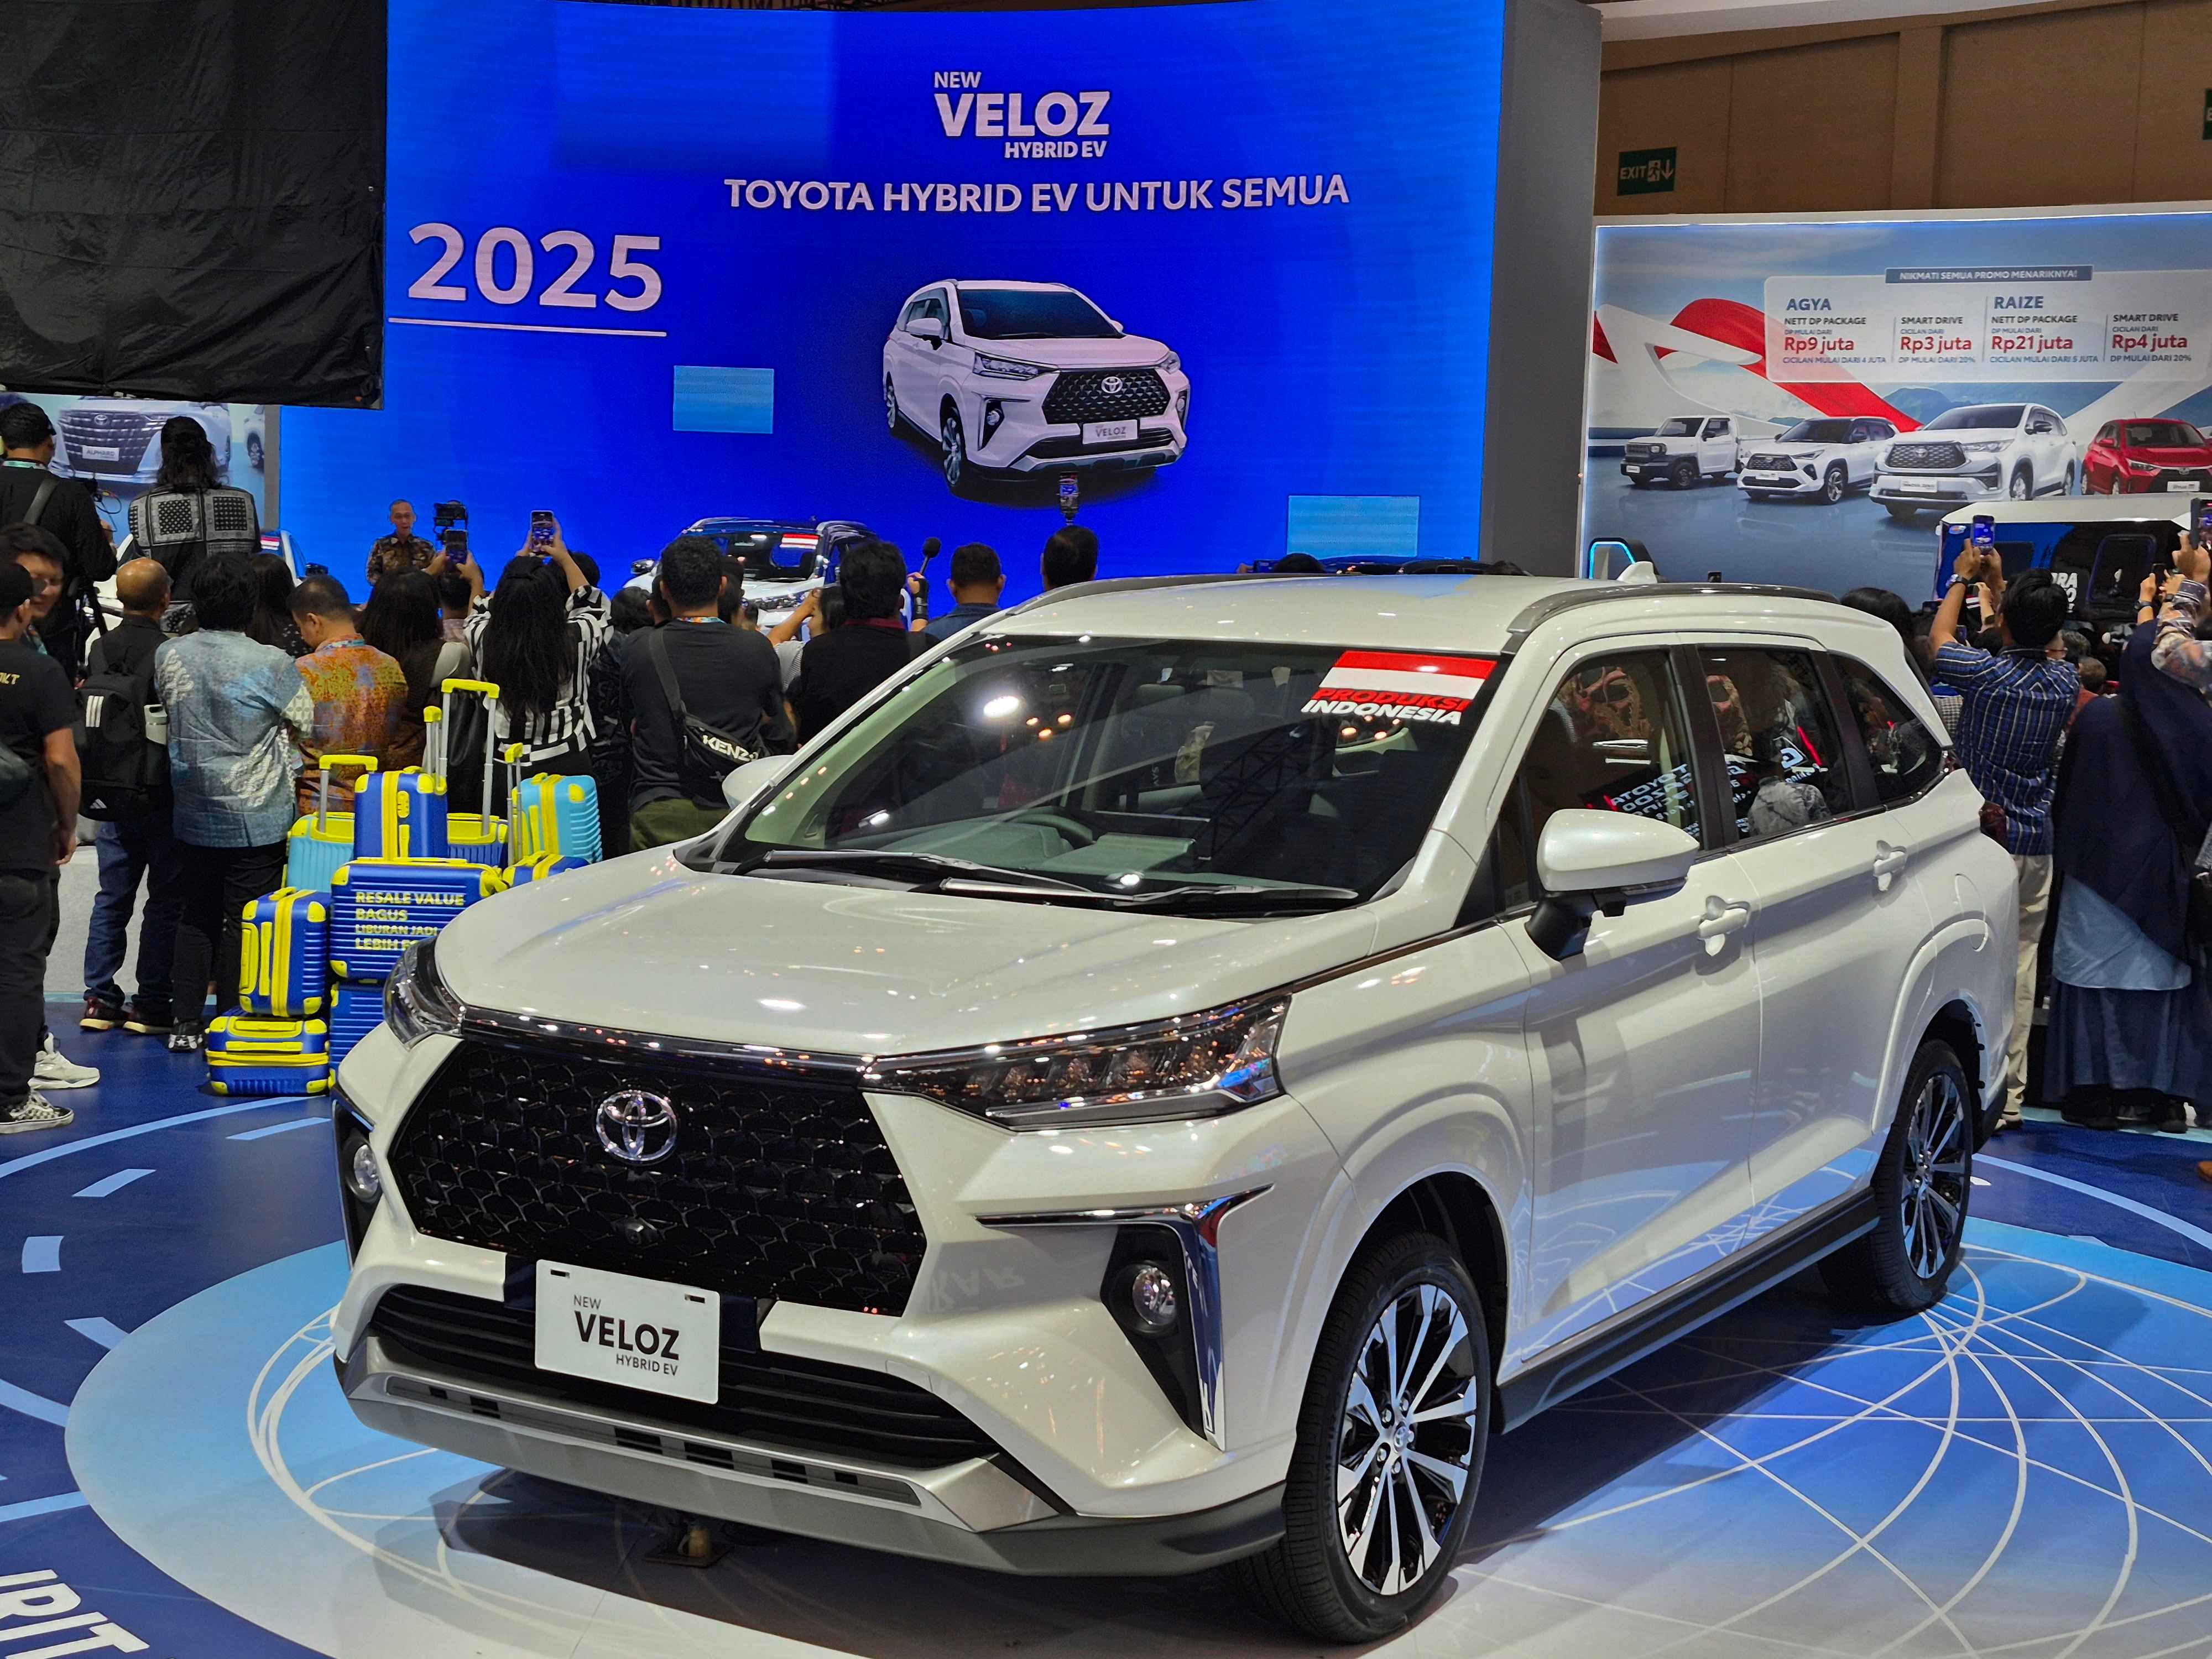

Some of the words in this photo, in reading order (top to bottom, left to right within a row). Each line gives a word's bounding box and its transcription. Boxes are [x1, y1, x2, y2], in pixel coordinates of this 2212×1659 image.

[934, 71, 982, 88] NEW
[933, 91, 1110, 137] VELOZ
[1004, 142, 1078, 158] HYBRID
[1081, 140, 1107, 158] EV
[1620, 166, 1647, 179] EXIT
[724, 179, 874, 210] TOYOTA
[883, 183, 1022, 212] HYBRID
[1032, 183, 1078, 212] EV
[1086, 179, 1213, 211] UNTUK
[1221, 175, 1350, 208] SEMUA
[408, 223, 662, 312] 2025
[2011, 270, 2078, 278] MENARIKNYA!
[1786, 298, 1832, 310] AGYA
[1994, 296, 2044, 309] RAIZE
[1785, 337, 1818, 354] Rp9
[1820, 336, 1854, 354] juta
[1901, 336, 1934, 353] Rp3
[1937, 336, 1972, 353] juta
[1992, 336, 2034, 353] Rp21
[2037, 335, 2073, 353] juta
[2112, 334, 2148, 352] Rp4
[2150, 333, 2187, 352] juta
[1095, 426, 1126, 437] VELOZ
[1310, 687, 1472, 711] PRODUKSI
[1301, 700, 1462, 725] INDONESIA
[356, 891, 411, 904] RESALE
[415, 893, 465, 905] VALUE
[356, 908, 408, 921] BAGUS
[355, 924, 408, 935] LIBURAN
[411, 926, 437, 936] JADI
[354, 937, 398, 950] LEBIH
[573, 1295, 601, 1310] NEW
[573, 1310, 679, 1360] VELOZ
[616, 1353, 660, 1373] HYBRID
[663, 1363, 678, 1376] EV
